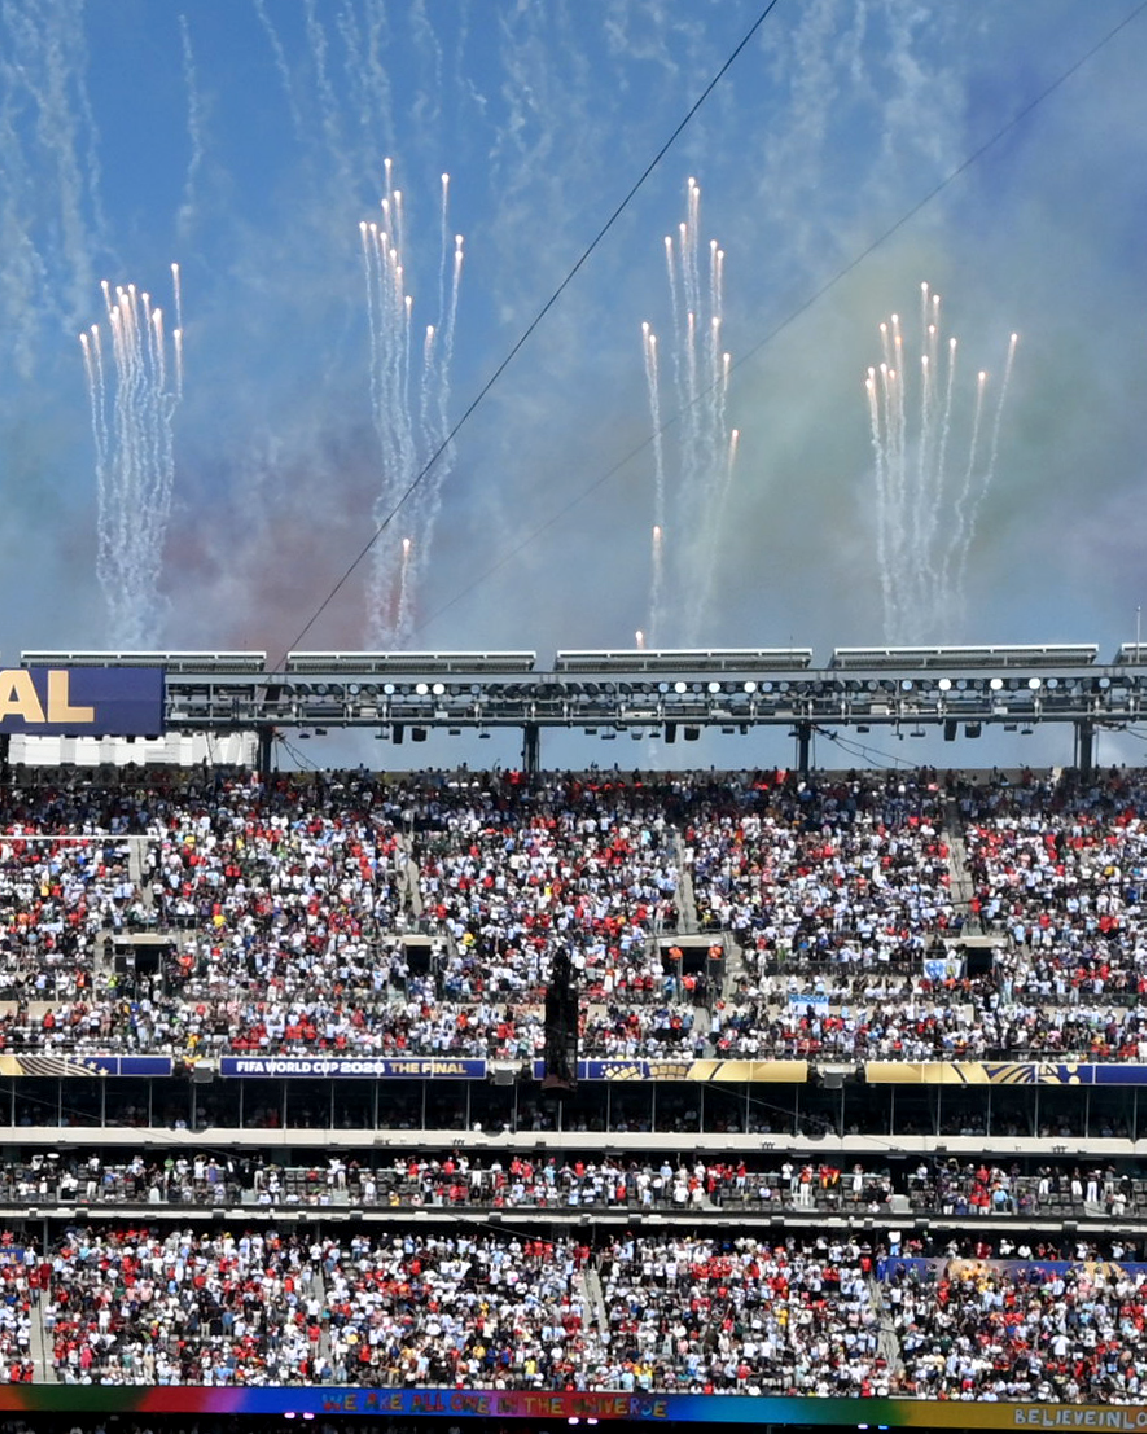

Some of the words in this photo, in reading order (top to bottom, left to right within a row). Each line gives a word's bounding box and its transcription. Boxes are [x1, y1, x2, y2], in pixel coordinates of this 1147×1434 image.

[236, 1061, 264, 1072] FIFA
[265, 1061, 311, 1072] WORLD
[313, 1062, 339, 1072] CUP
[340, 1062, 385, 1073] 2026
[390, 1063, 420, 1073] THE
[422, 1063, 466, 1073] FINAL
[322, 1392, 357, 1412] WE
[364, 1392, 402, 1412] ARE
[411, 1393, 446, 1412] ALL
[450, 1393, 490, 1413] ONE
[499, 1395, 518, 1414] IN
[523, 1396, 566, 1414] THE
[573, 1396, 668, 1418] UNIVERSE
